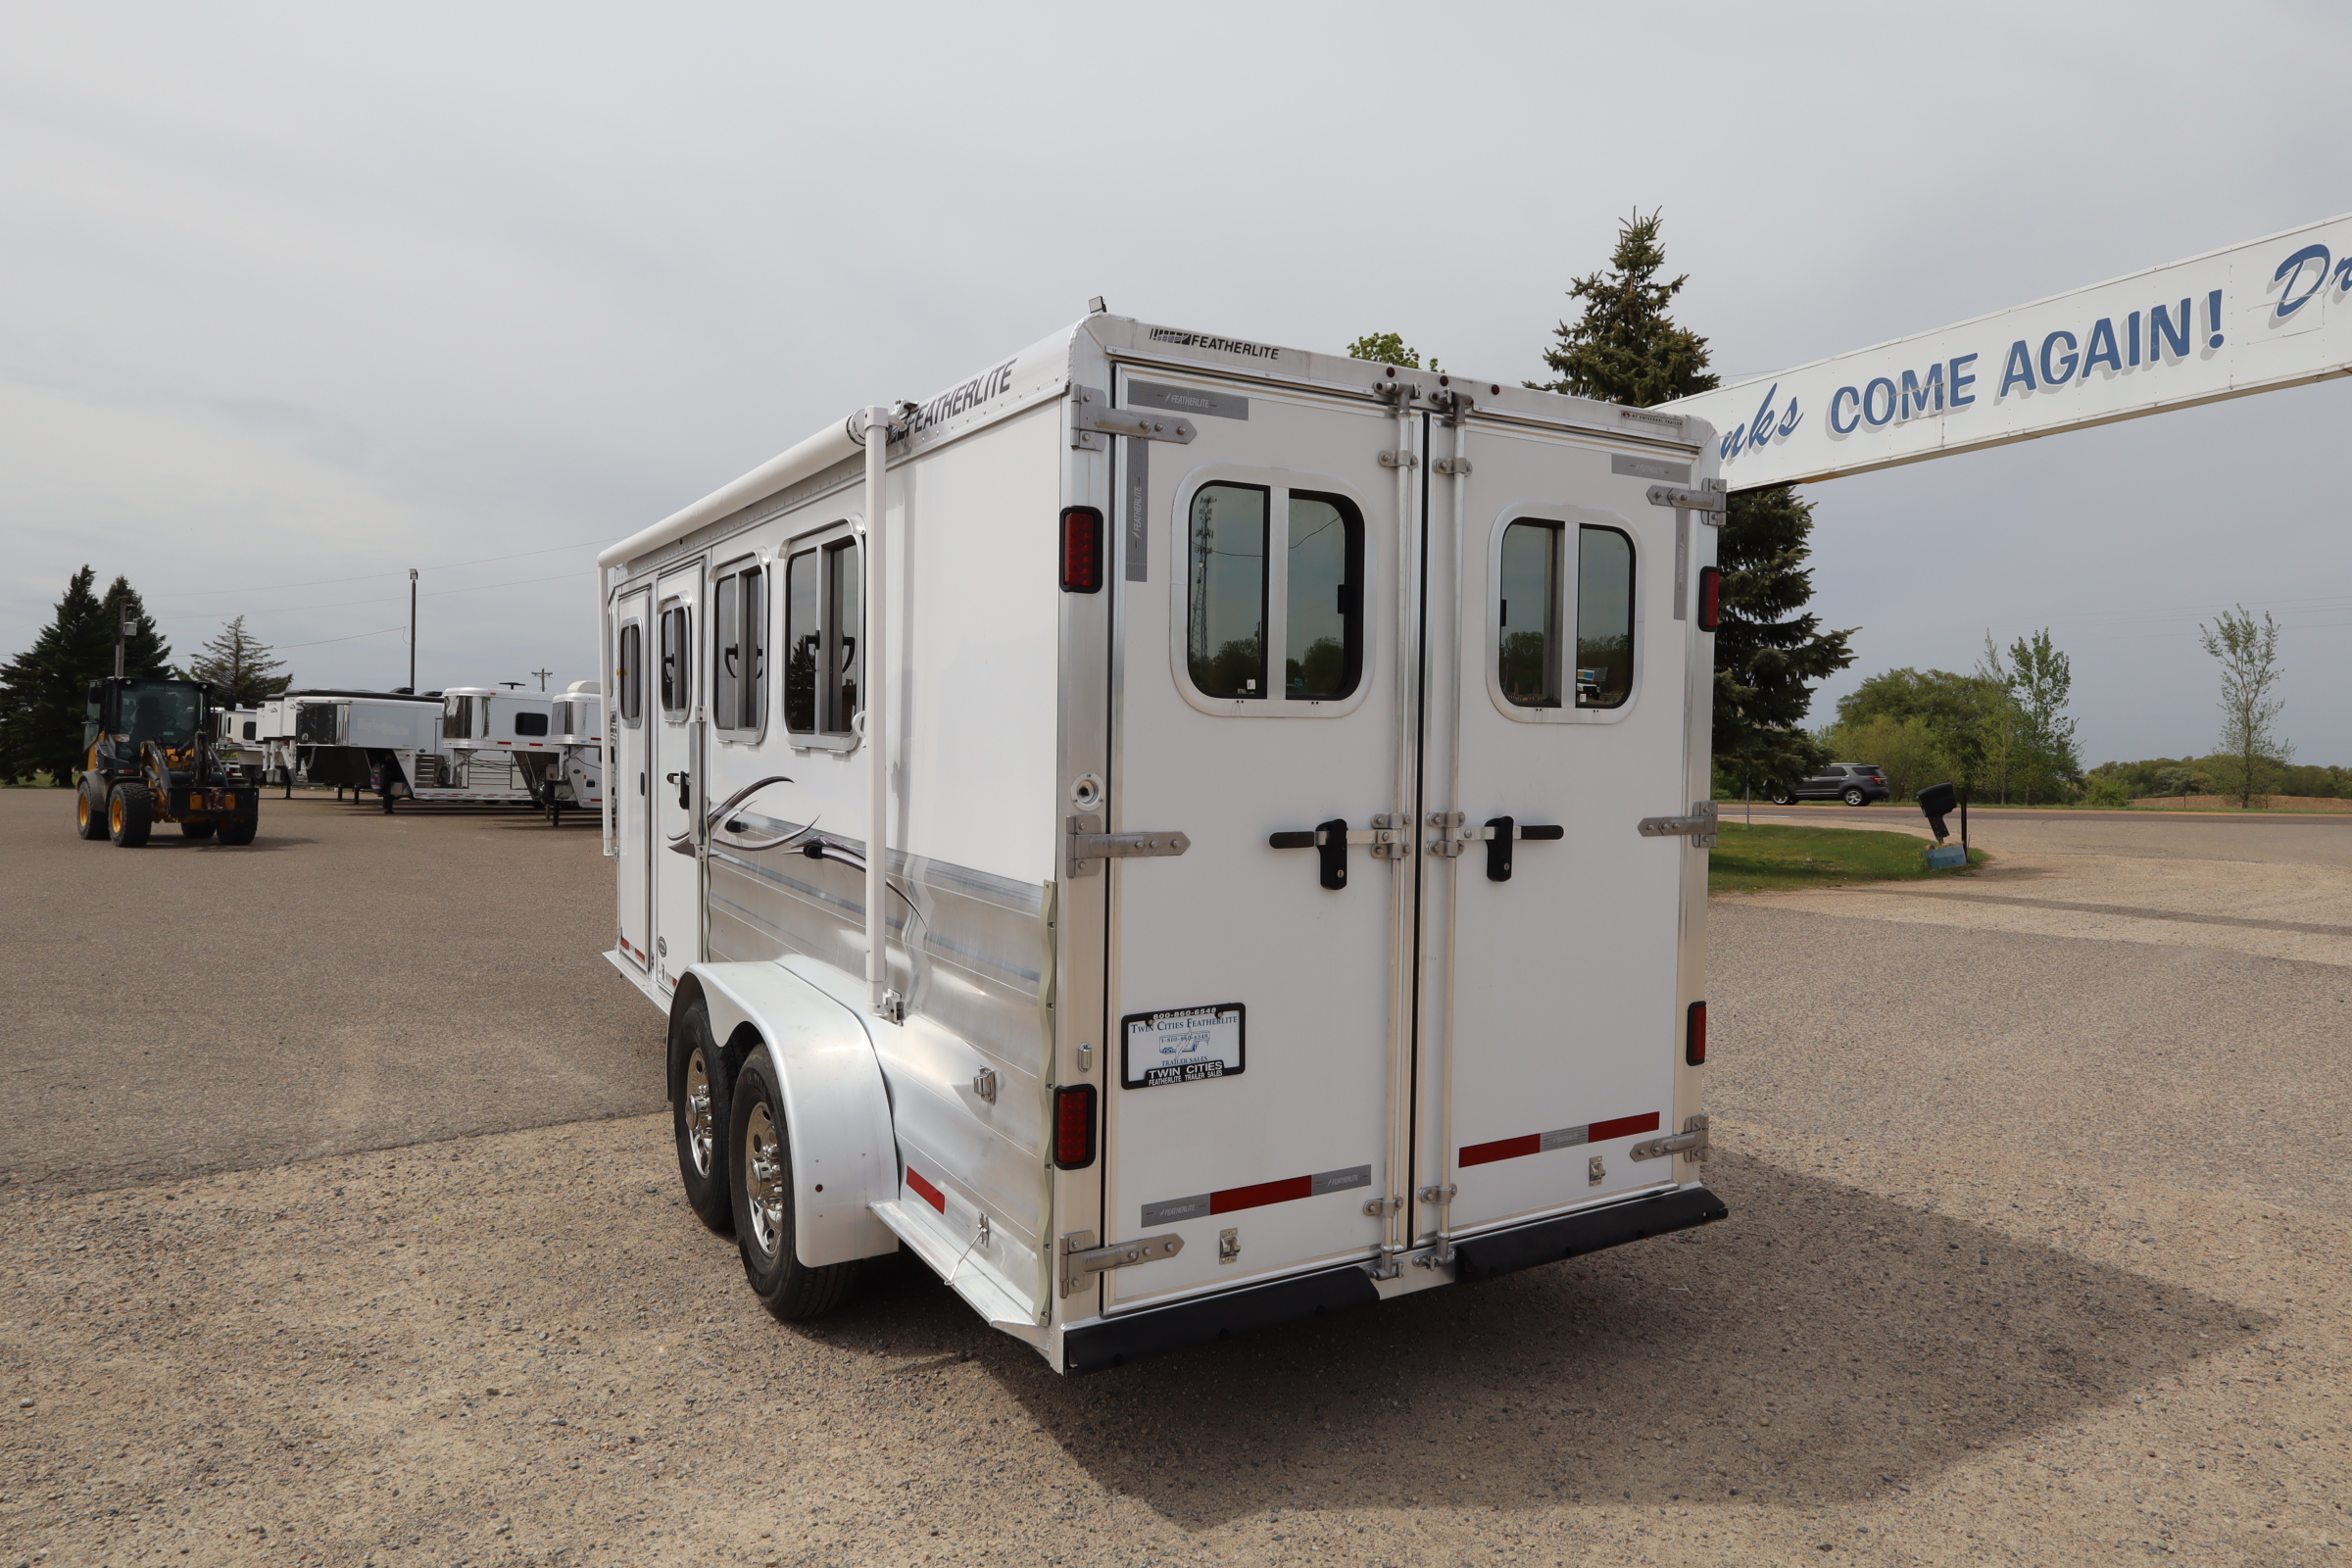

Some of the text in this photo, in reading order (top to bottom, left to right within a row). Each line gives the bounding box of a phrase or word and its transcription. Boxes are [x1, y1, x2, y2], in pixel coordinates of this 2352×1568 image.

[1191, 335, 1280, 361] FEATHERLITE
[1830, 353, 1978, 435] COME
[2000, 289, 2225, 397] AGAIN!
[906, 357, 1018, 437] FEATHERLITE
[1170, 395, 1210, 409] FEATHERLITE
[1133, 485, 1143, 532] FEATHERLITE
[1152, 1006, 1217, 1020] 800-860-6548
[1131, 1015, 1238, 1034] TWIN CITIES FEATHERLITE
[1149, 1061, 1223, 1079] TWIN CITIES
[1161, 1057, 1188, 1066] TRAILER
[1149, 1069, 1223, 1087] FEATHERLITE TRAILER SALES
[1331, 1174, 1359, 1186] FEATHERLITE
[1164, 1203, 1197, 1216] FEATHERLITE
